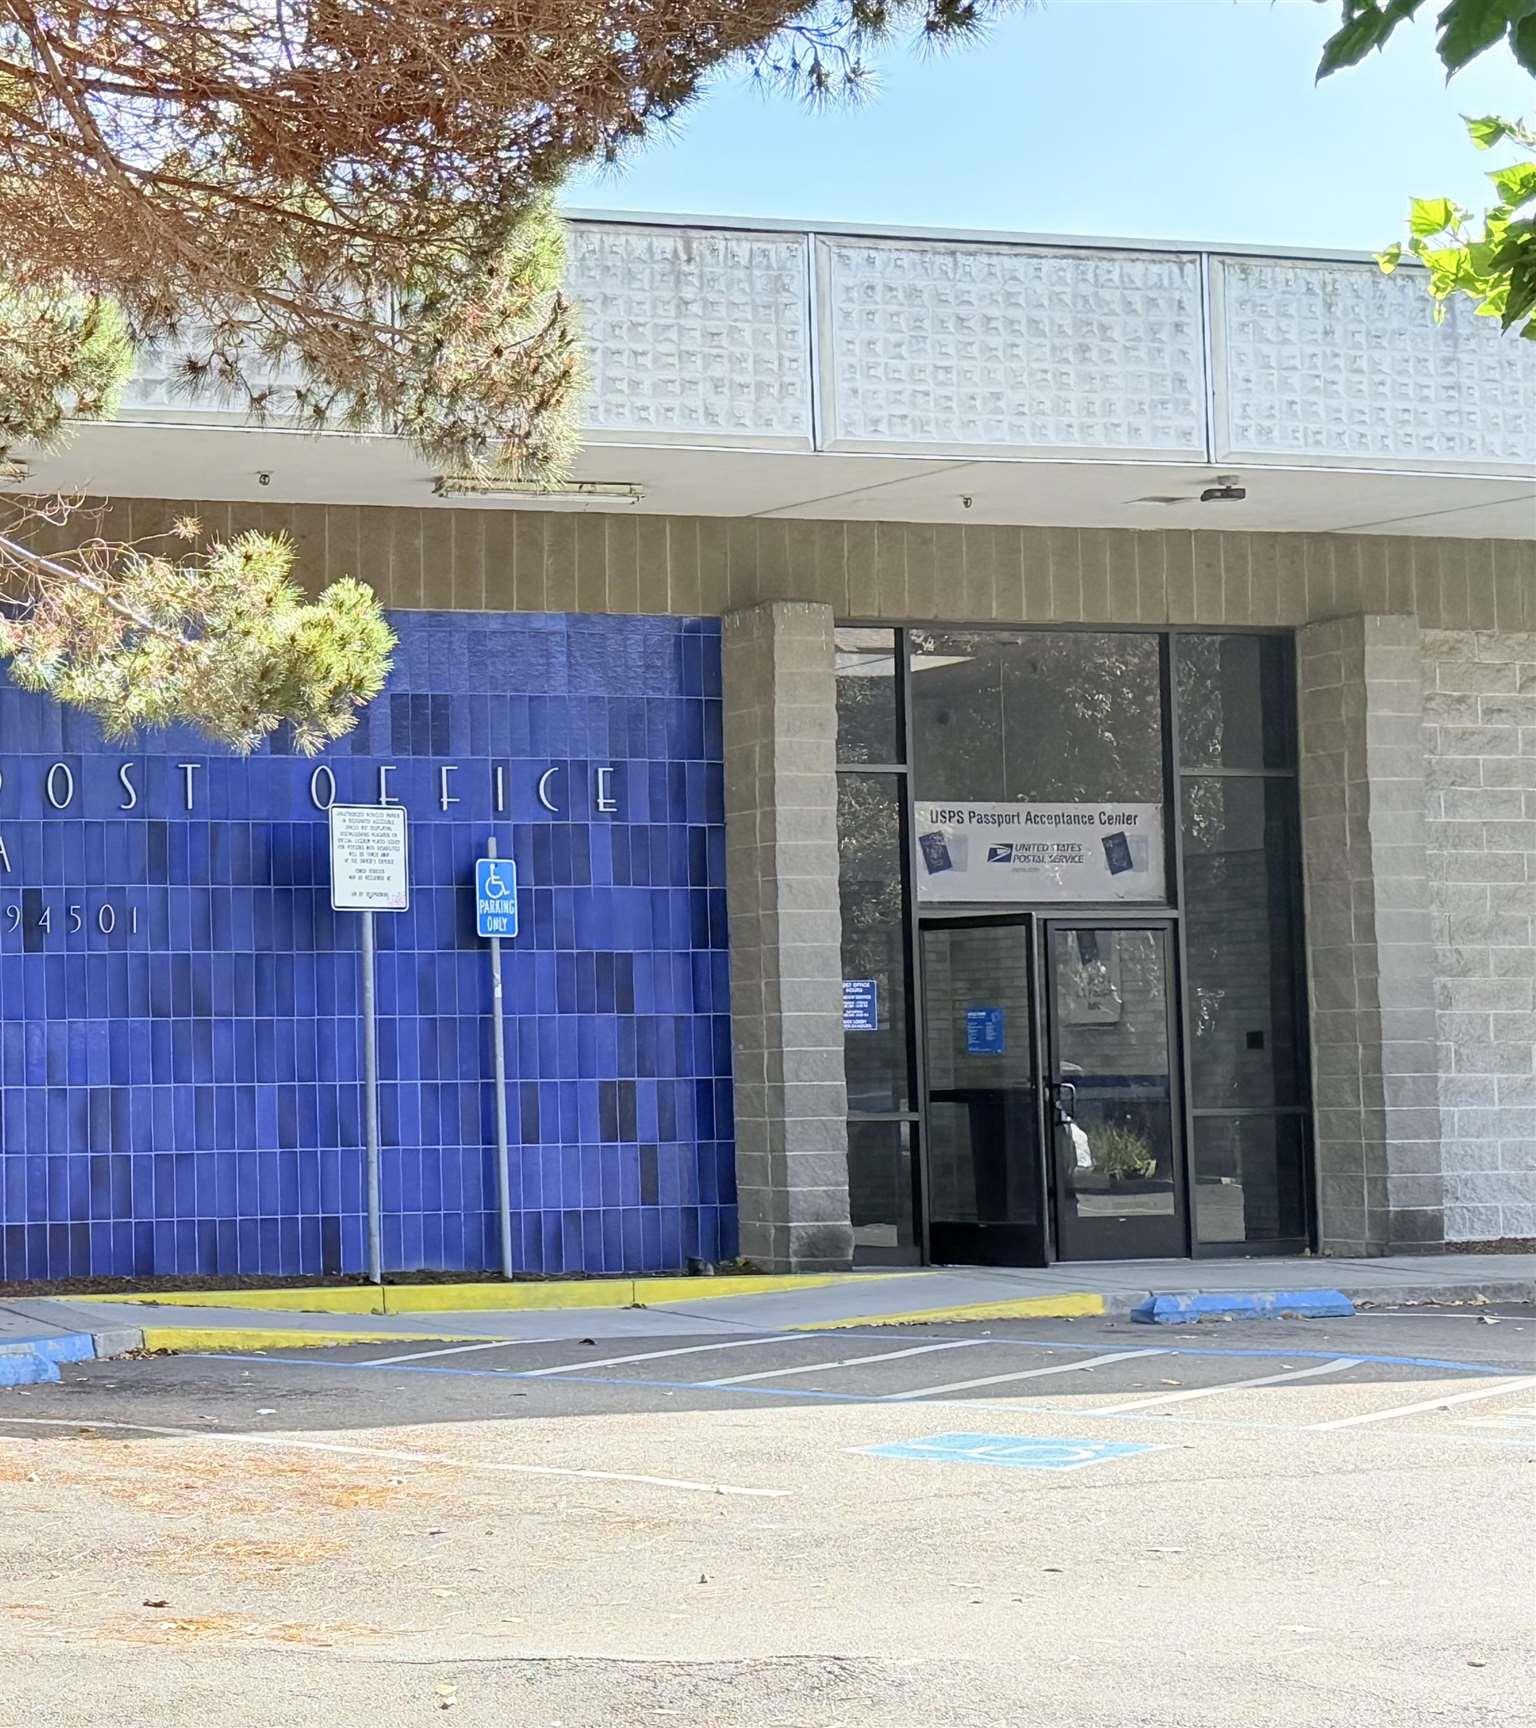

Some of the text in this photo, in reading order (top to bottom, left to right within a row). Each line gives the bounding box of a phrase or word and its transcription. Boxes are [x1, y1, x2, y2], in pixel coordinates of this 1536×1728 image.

[311, 764, 619, 814] OFFICE
[930, 809, 1139, 828] USPS Passport Acceptance Center
[1014, 843, 1083, 853] UNITED STATES
[1013, 854, 1085, 864] POSTAL SERVICE
[479, 899, 515, 914] PARKING
[5, 904, 141, 936] 94501
[486, 915, 508, 932] ONLY
